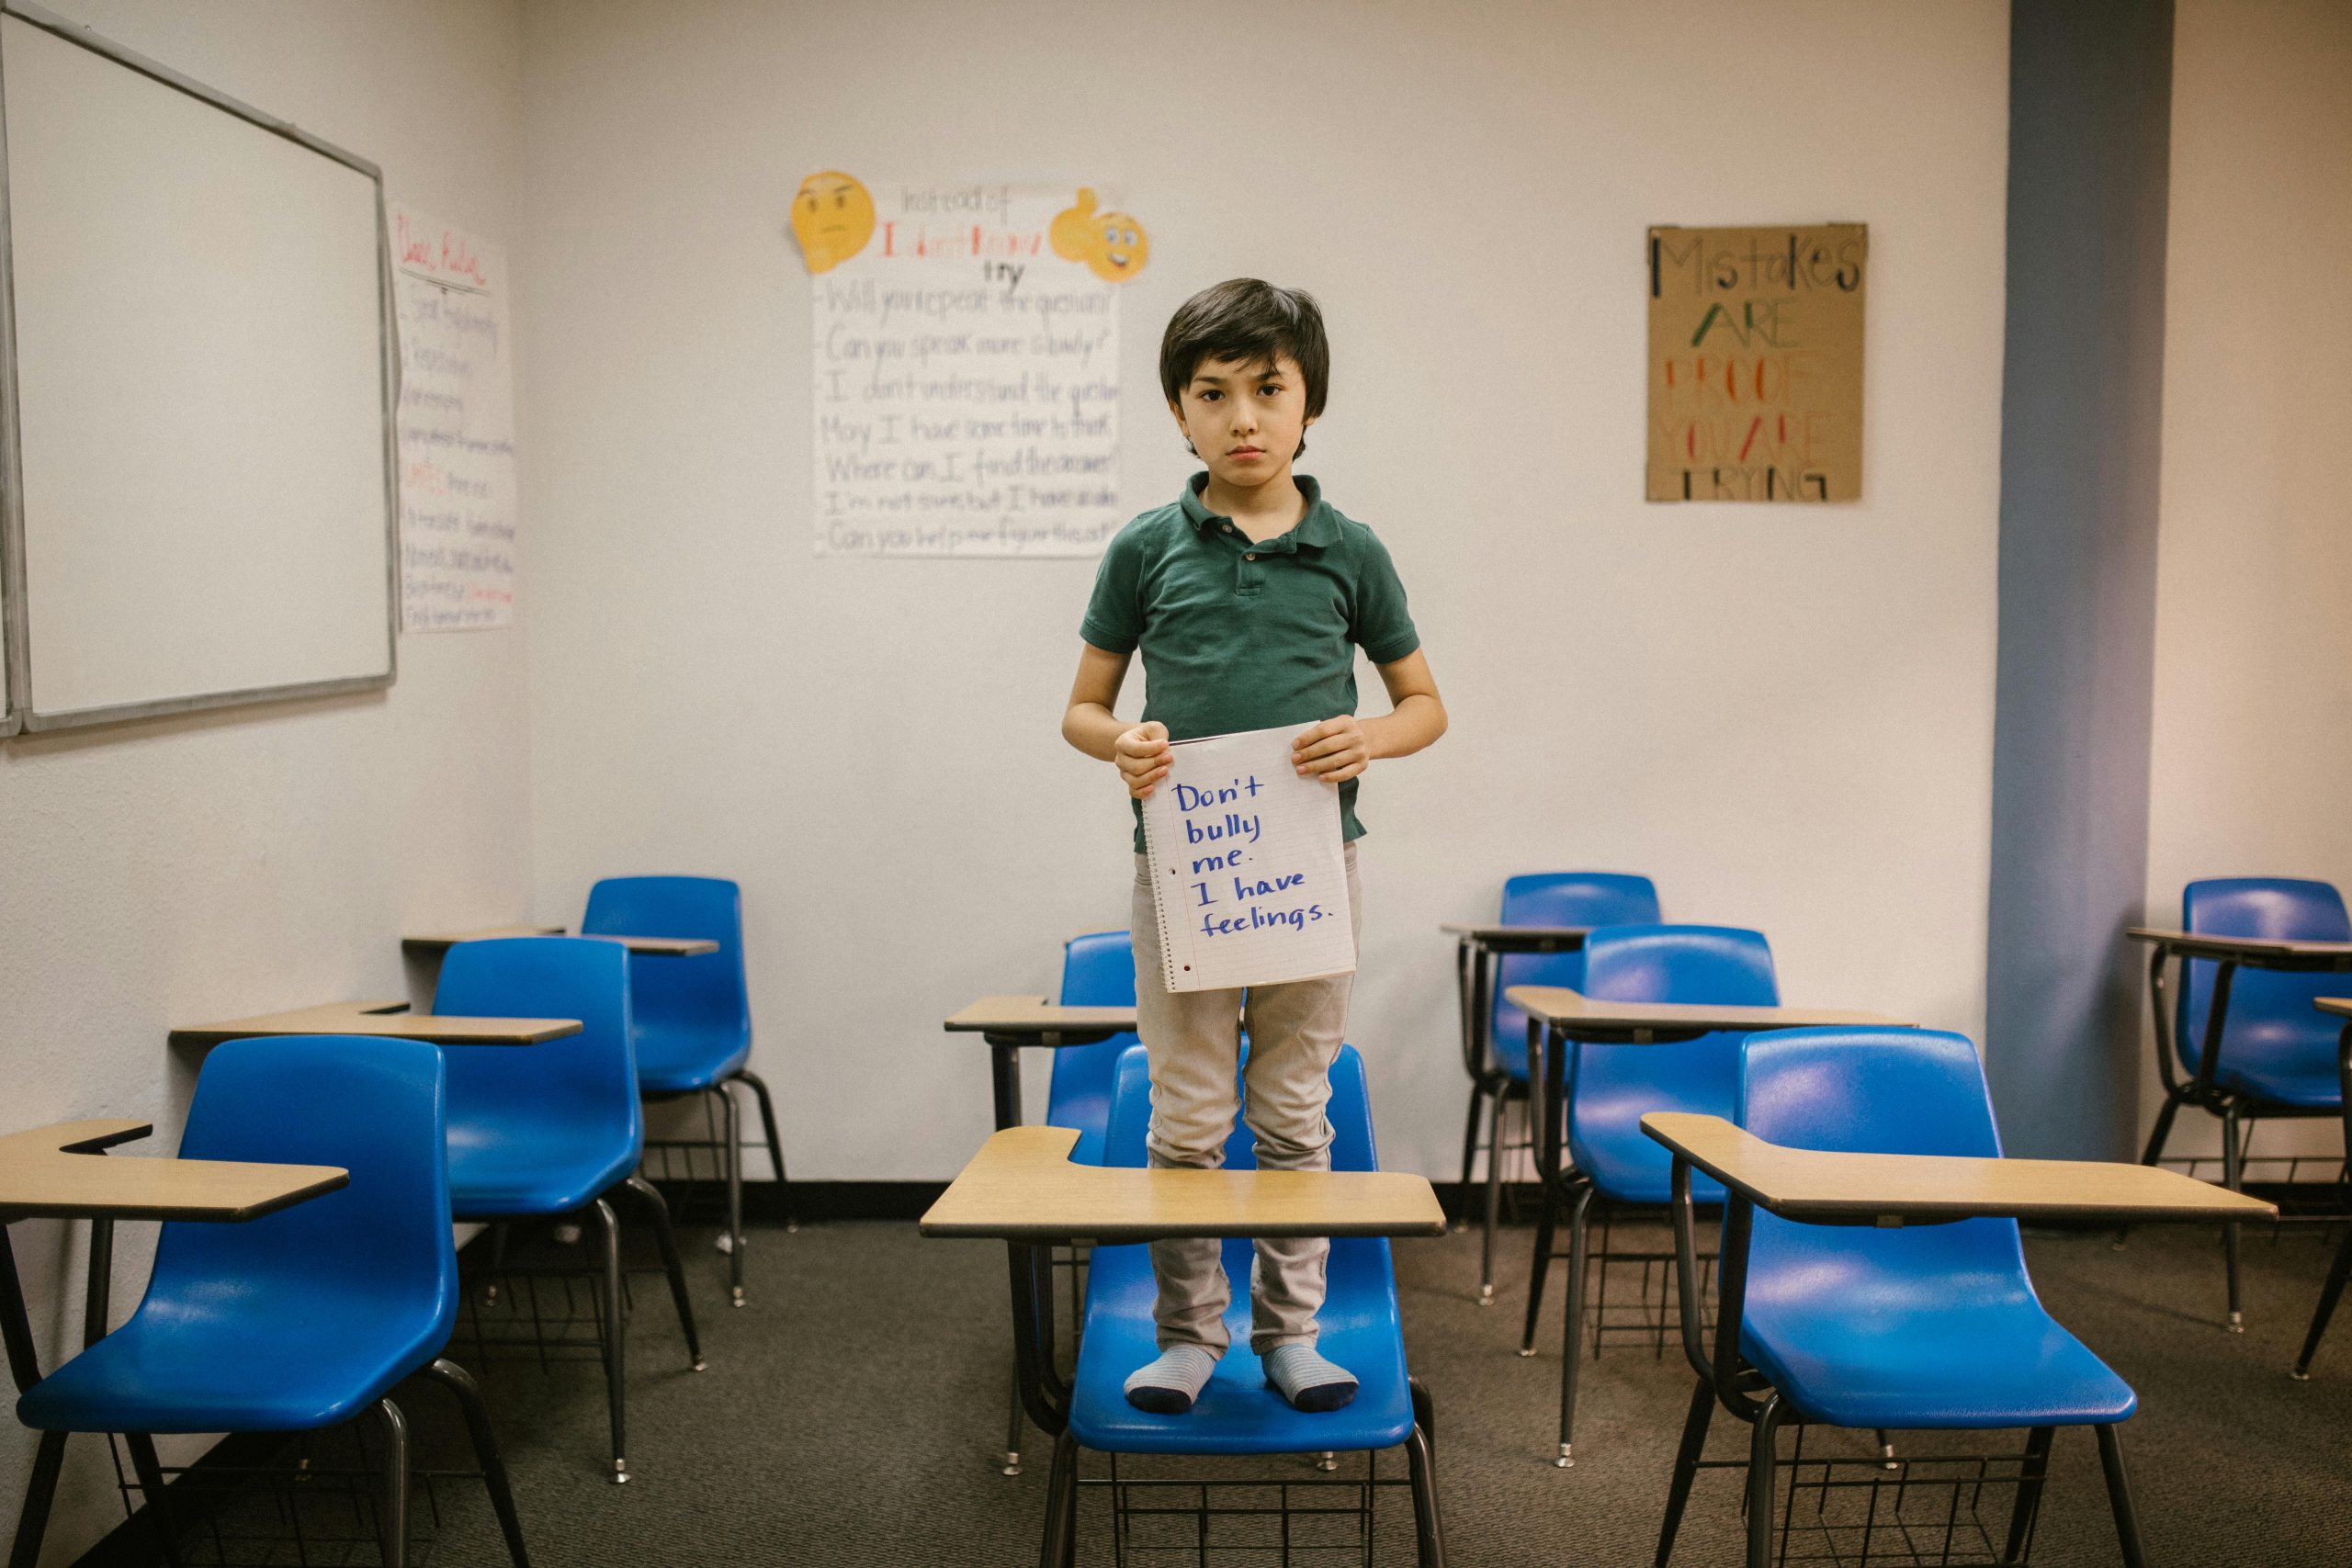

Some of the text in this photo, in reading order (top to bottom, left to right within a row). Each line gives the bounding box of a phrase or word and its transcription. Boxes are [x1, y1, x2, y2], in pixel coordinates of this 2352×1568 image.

[879, 221, 900, 257] I
[983, 259, 1026, 295] try
[1651, 234, 1860, 299] Mistakes
[1690, 296, 1803, 348] ARE
[823, 368, 848, 402] I
[1665, 350, 1822, 405] PROOF
[877, 414, 900, 445] I
[1657, 412, 1837, 463] YOU ARE
[937, 453, 964, 483] I
[1668, 462, 1829, 502] TRYING
[1171, 775, 1265, 812] Don't
[1185, 814, 1261, 844] bully
[1192, 849, 1254, 874] me.
[1191, 873, 1306, 908] I have
[1200, 904, 1335, 938] feelings.
